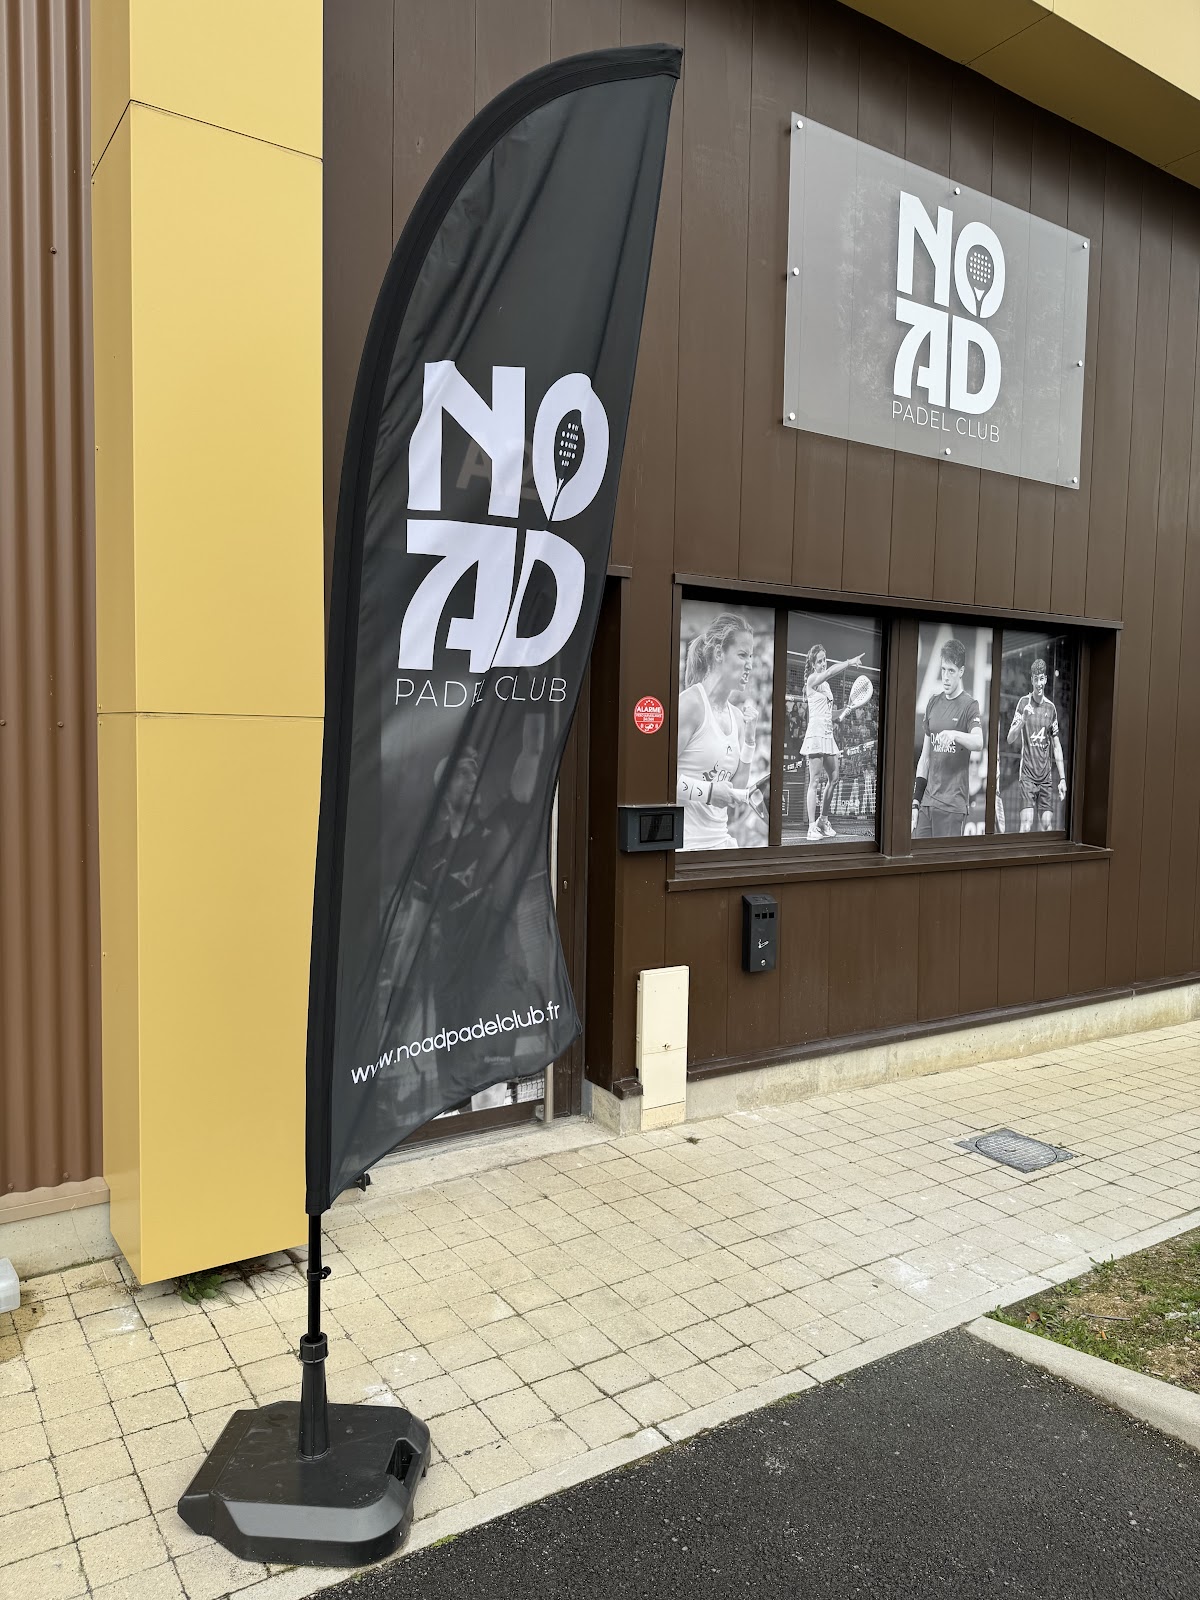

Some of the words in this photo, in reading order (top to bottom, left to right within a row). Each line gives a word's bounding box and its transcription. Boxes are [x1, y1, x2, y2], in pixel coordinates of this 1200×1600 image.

[896, 190, 1006, 319] NO
[893, 296, 1002, 415] AD
[407, 360, 610, 522] NO
[891, 400, 951, 432] PADEL
[955, 416, 1001, 443] CLUB
[398, 519, 586, 674] AD
[395, 678, 485, 708] PADEL
[494, 675, 568, 702] CLUB
